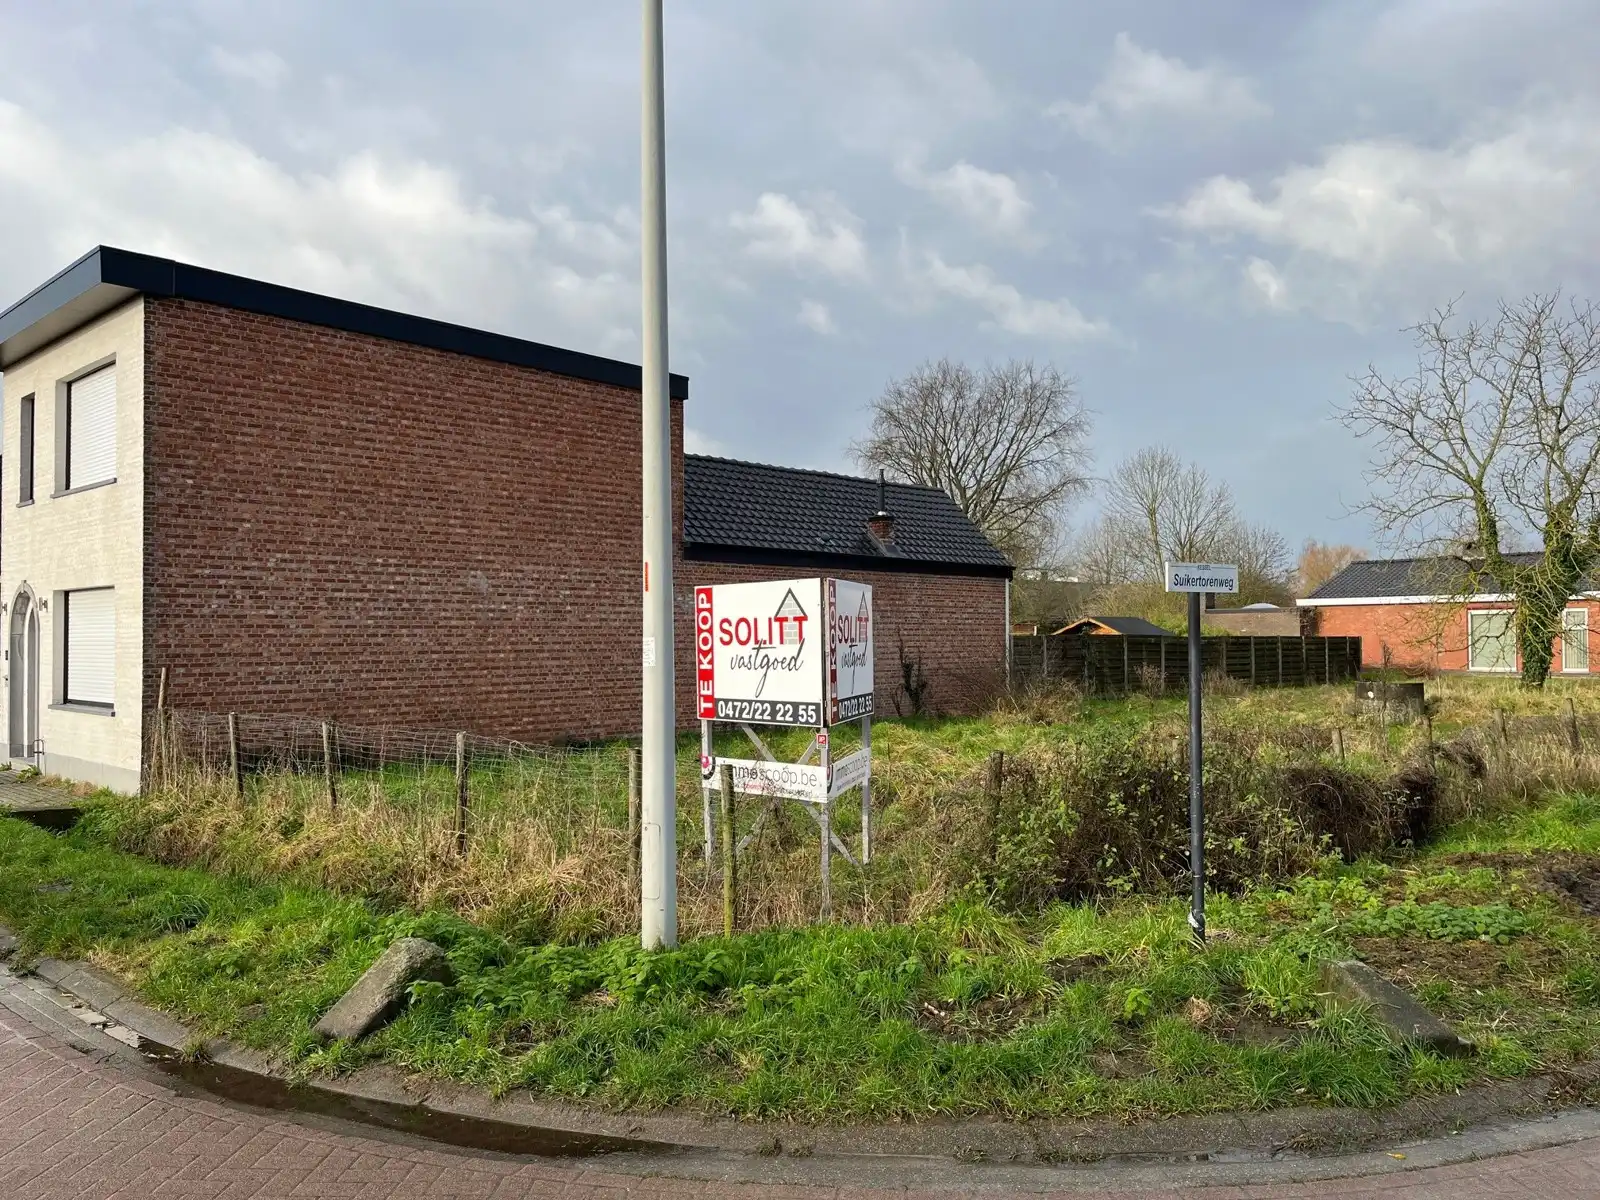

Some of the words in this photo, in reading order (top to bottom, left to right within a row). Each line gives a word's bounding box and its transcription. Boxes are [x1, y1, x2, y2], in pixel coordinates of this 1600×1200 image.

[1174, 573, 1234, 591] Suikertorenweg
[698, 593, 713, 670] KOOP
[719, 616, 808, 646] SOLITT
[838, 615, 869, 643] SOLITT
[730, 638, 805, 698] vastgoed
[700, 680, 713, 713] TE
[859, 697, 865, 712] 22
[866, 695, 872, 711] 55
[718, 700, 772, 720] 0472/22
[776, 704, 793, 721] 22
[798, 705, 816, 723] 55
